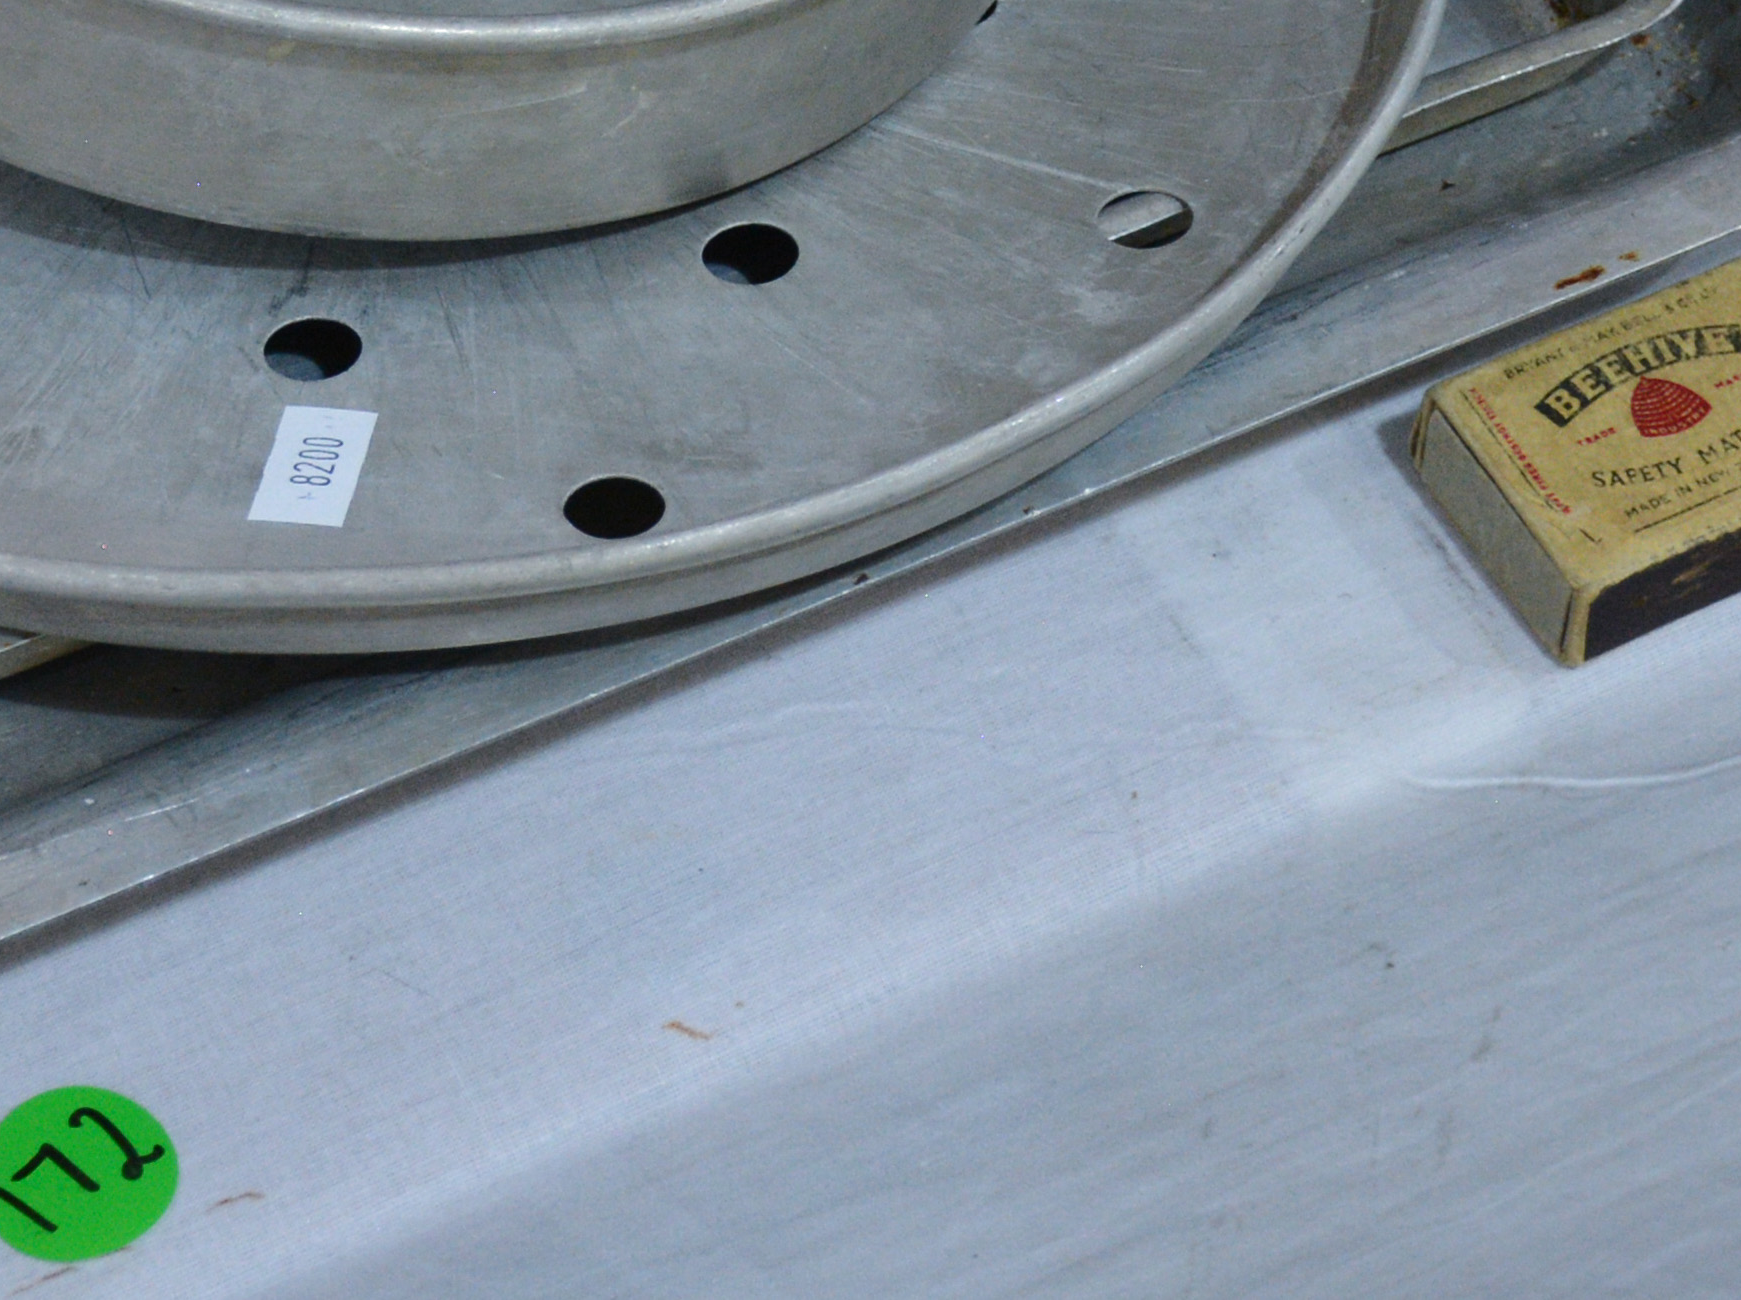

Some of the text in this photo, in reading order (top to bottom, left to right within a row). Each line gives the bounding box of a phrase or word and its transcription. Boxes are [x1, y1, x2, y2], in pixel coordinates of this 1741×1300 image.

[1542, 326, 1737, 422] BEEHIVE
[1576, 426, 1617, 447] TRADE
[289, 436, 344, 487] 8200
[1591, 456, 1684, 489] SAFETY
[1624, 493, 1672, 520] MADE
[1676, 482, 1693, 498] IN
